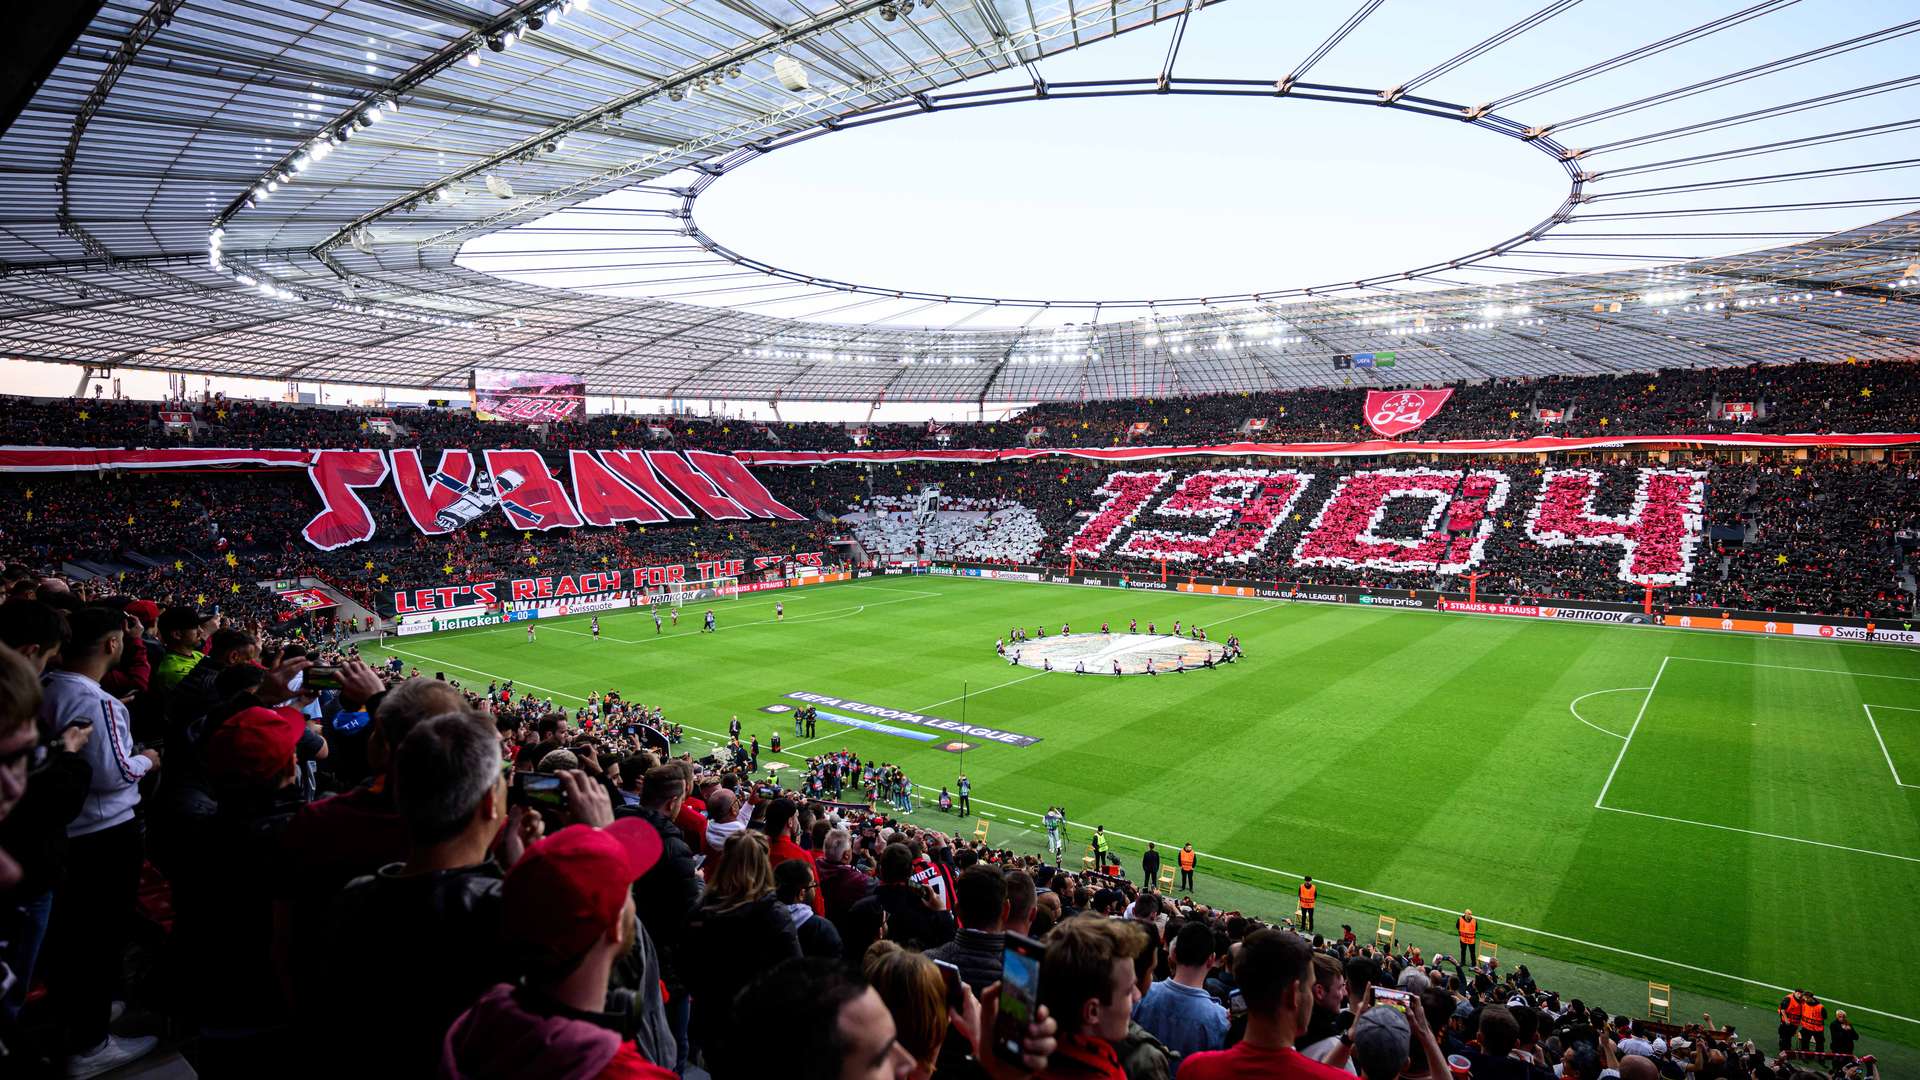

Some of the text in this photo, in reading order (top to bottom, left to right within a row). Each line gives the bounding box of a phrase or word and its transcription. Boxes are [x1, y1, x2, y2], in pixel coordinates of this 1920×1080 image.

[1372, 411, 1422, 425] 04
[1061, 468, 1707, 586] 1904
[885, 567, 903, 575] bwin
[395, 582, 497, 613] LET'S
[511, 571, 622, 601] REACH
[633, 564, 685, 588] FOR
[696, 559, 745, 580] THE
[760, 580, 783, 589] STRAUSS
[1052, 575, 1101, 585] bwin bwin
[1308, 593, 1336, 601] LEAGUE
[1363, 596, 1423, 606] enterprise
[569, 602, 612, 614] Swissquote
[1450, 602, 1536, 614] STRAUSS STRAUSS
[438, 614, 501, 631] Heineken
[788, 692, 1022, 743] UEFA EUROPA LEAGUE
